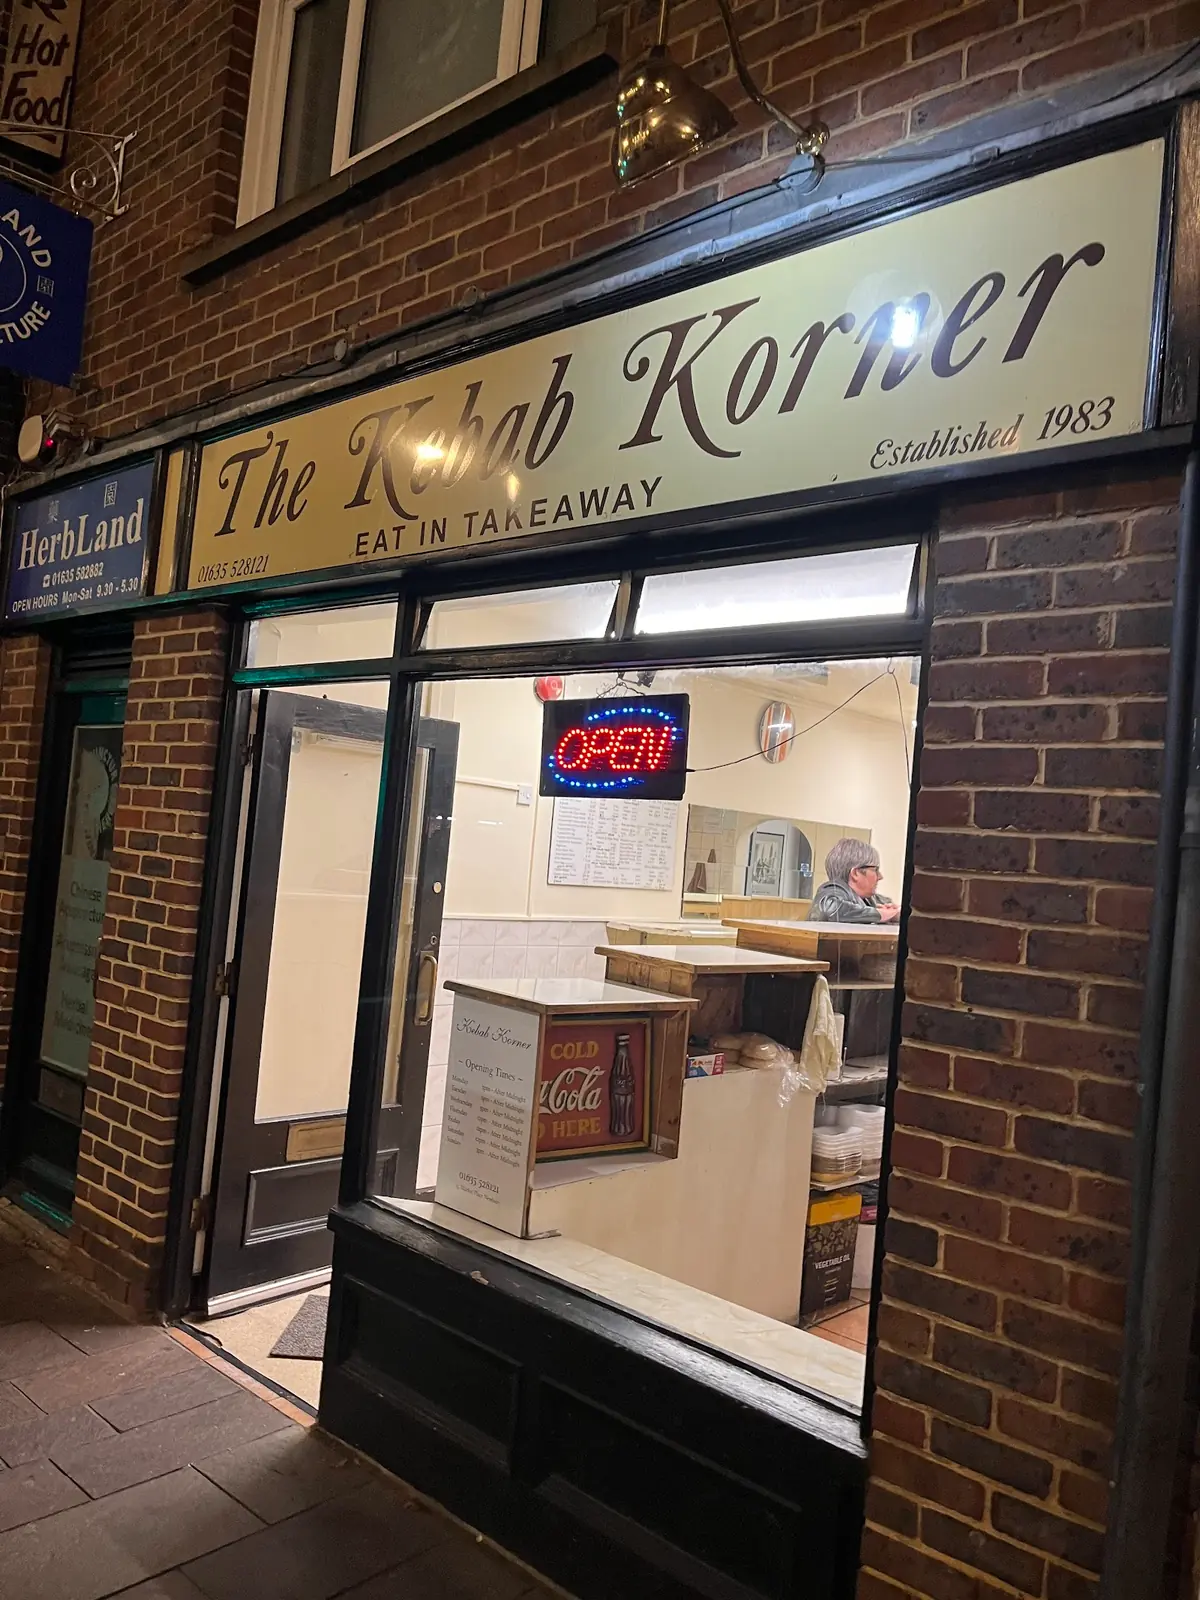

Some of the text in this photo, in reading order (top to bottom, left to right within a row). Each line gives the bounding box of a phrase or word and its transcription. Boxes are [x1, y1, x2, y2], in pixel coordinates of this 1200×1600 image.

[11, 24, 70, 66] Hot
[1, 70, 73, 125] Food
[0, 208, 52, 268] AND
[0, 301, 51, 343] TURE
[214, 242, 1106, 536] The Kebab Korner
[870, 396, 1116, 470] Established 1983
[18, 498, 144, 570] HerbLand
[354, 476, 664, 557] EAT IN TAKEAWAY
[52, 568, 75, 586] 01635
[197, 555, 270, 583] 01635 528121
[12, 600, 31, 613] OPEN
[32, 595, 59, 608] HOURS
[62, 587, 93, 603] Mon-Sat
[96, 582, 114, 598] 9.30
[120, 576, 139, 593] 5.30
[557, 726, 670, 770] OPEN
[457, 1017, 532, 1050] Kebab Korner
[550, 1041, 600, 1060] COLD
[465, 1058, 493, 1078] Opening
[495, 1066, 516, 1082] Times
[552, 1117, 601, 1139] HERE
[458, 1171, 500, 1194] 01635 528121
[814, 1255, 843, 1270] VEGETABLE
